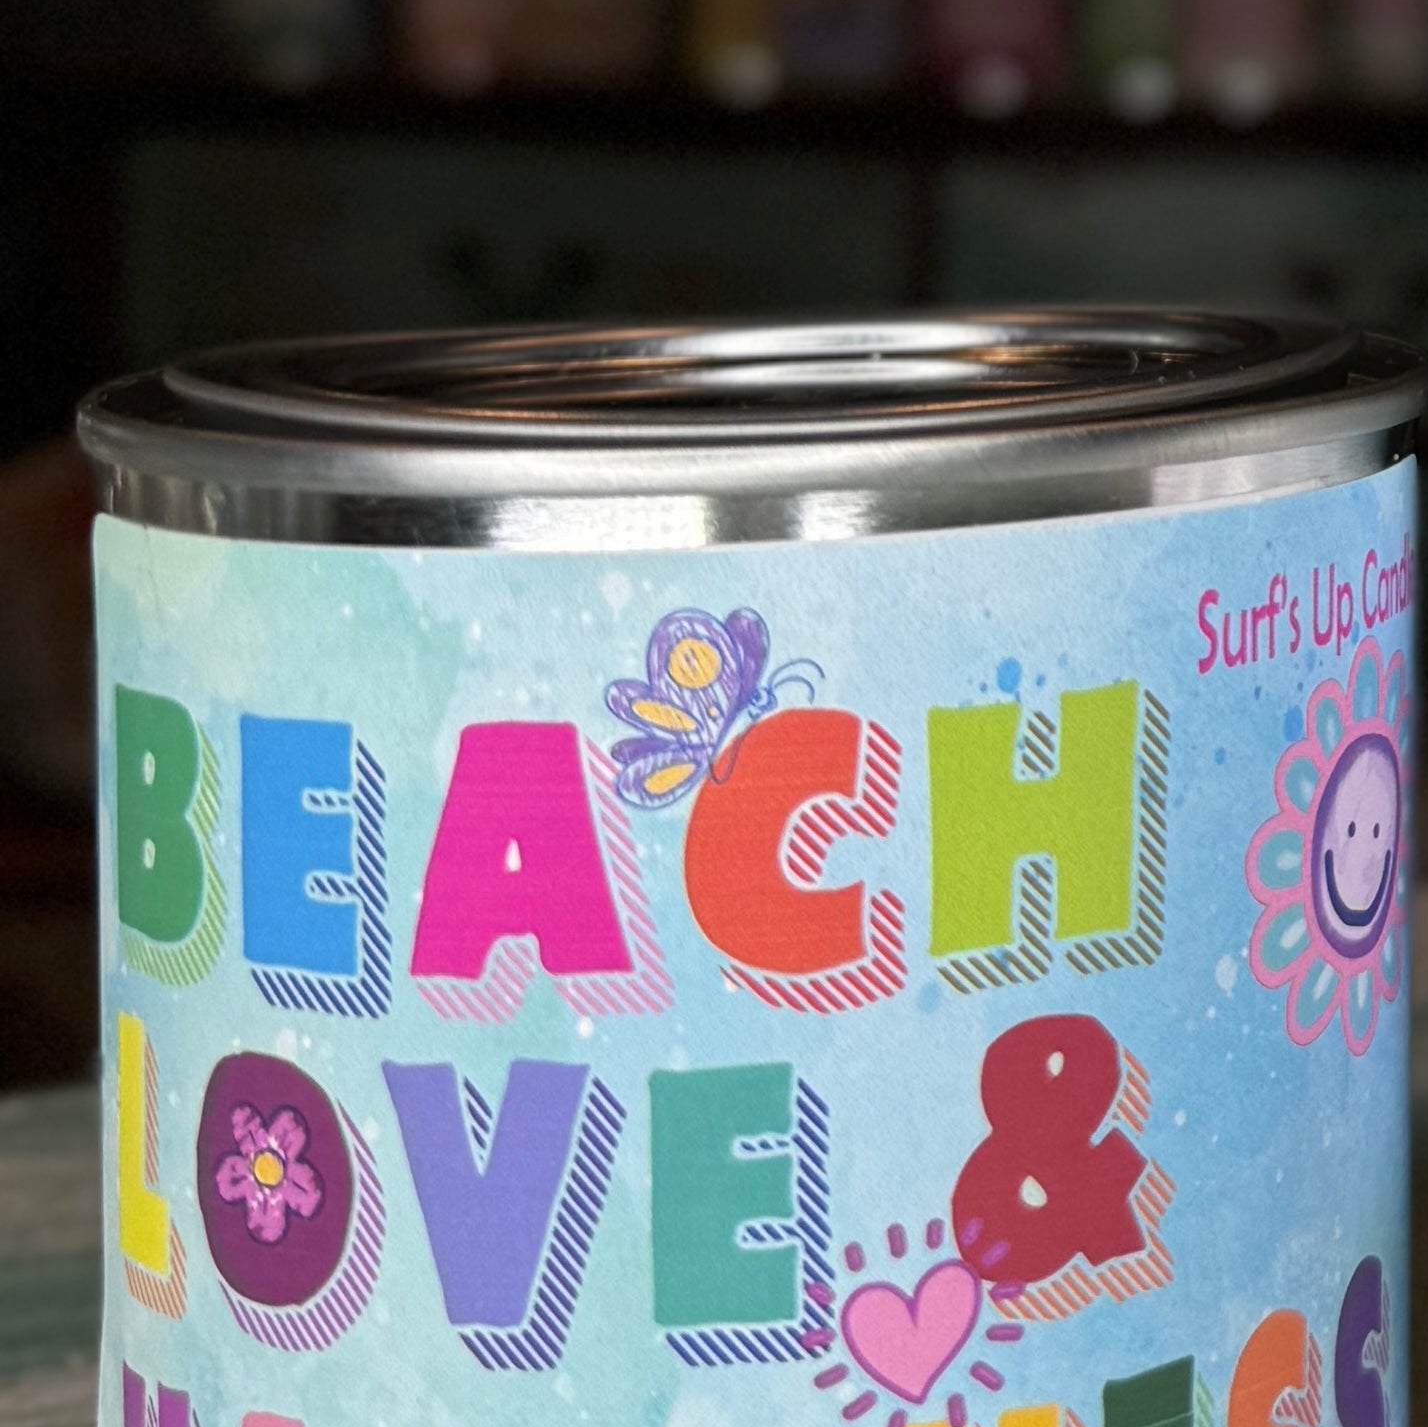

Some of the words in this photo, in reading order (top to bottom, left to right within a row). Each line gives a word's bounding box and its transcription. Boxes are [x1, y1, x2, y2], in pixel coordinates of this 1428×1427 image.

[1197, 572, 1301, 675] Surf's
[1312, 562, 1354, 657] Up
[1362, 531, 1414, 629] Cand
[115, 678, 1171, 1024] BEACH
[117, 1012, 832, 1371] LOVE
[950, 1012, 1177, 1325] &
